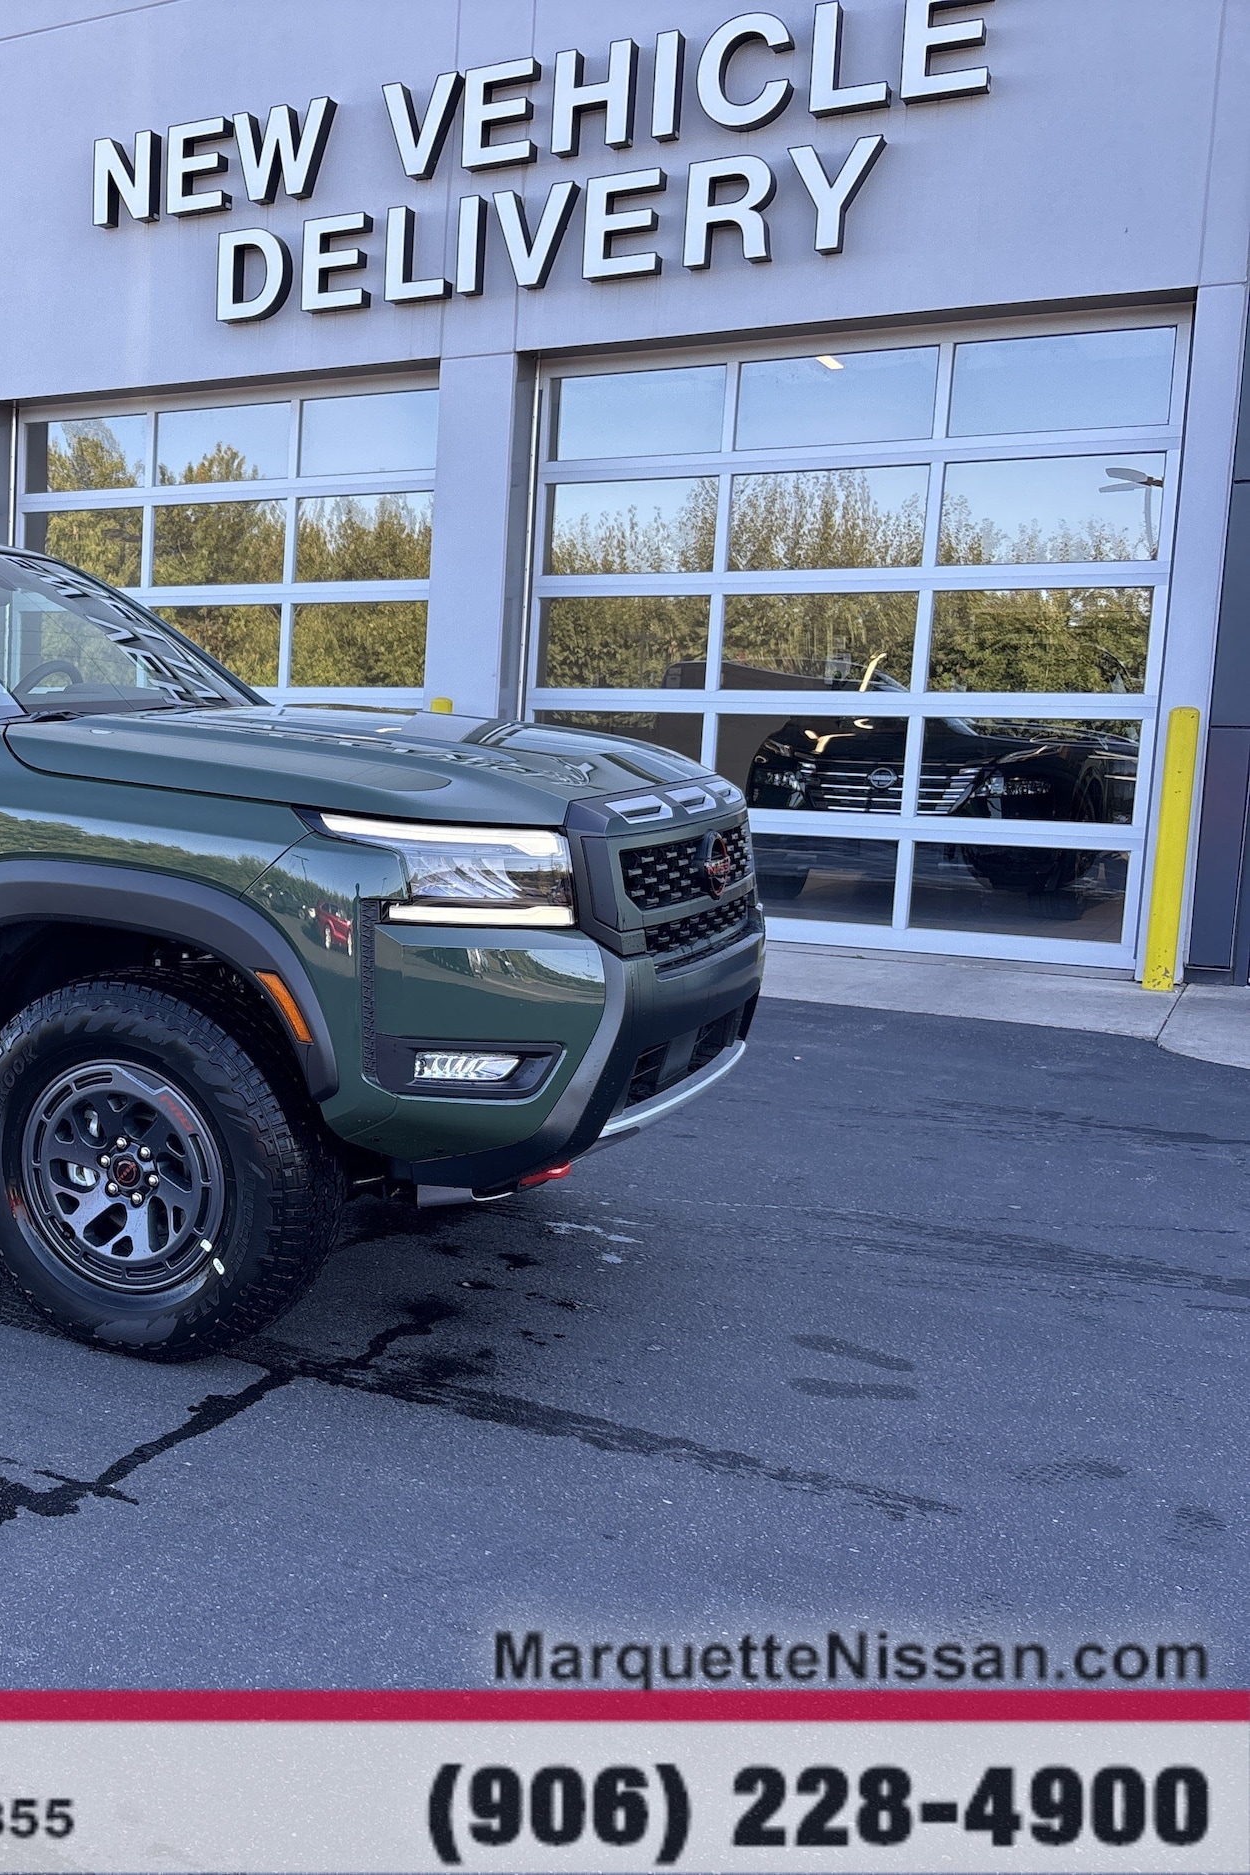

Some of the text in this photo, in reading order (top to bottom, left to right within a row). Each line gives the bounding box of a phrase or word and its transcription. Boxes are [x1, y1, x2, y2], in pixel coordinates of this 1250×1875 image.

[91, 0, 994, 228] NEW VEHICLE
[216, 134, 886, 324] DELIVERY
